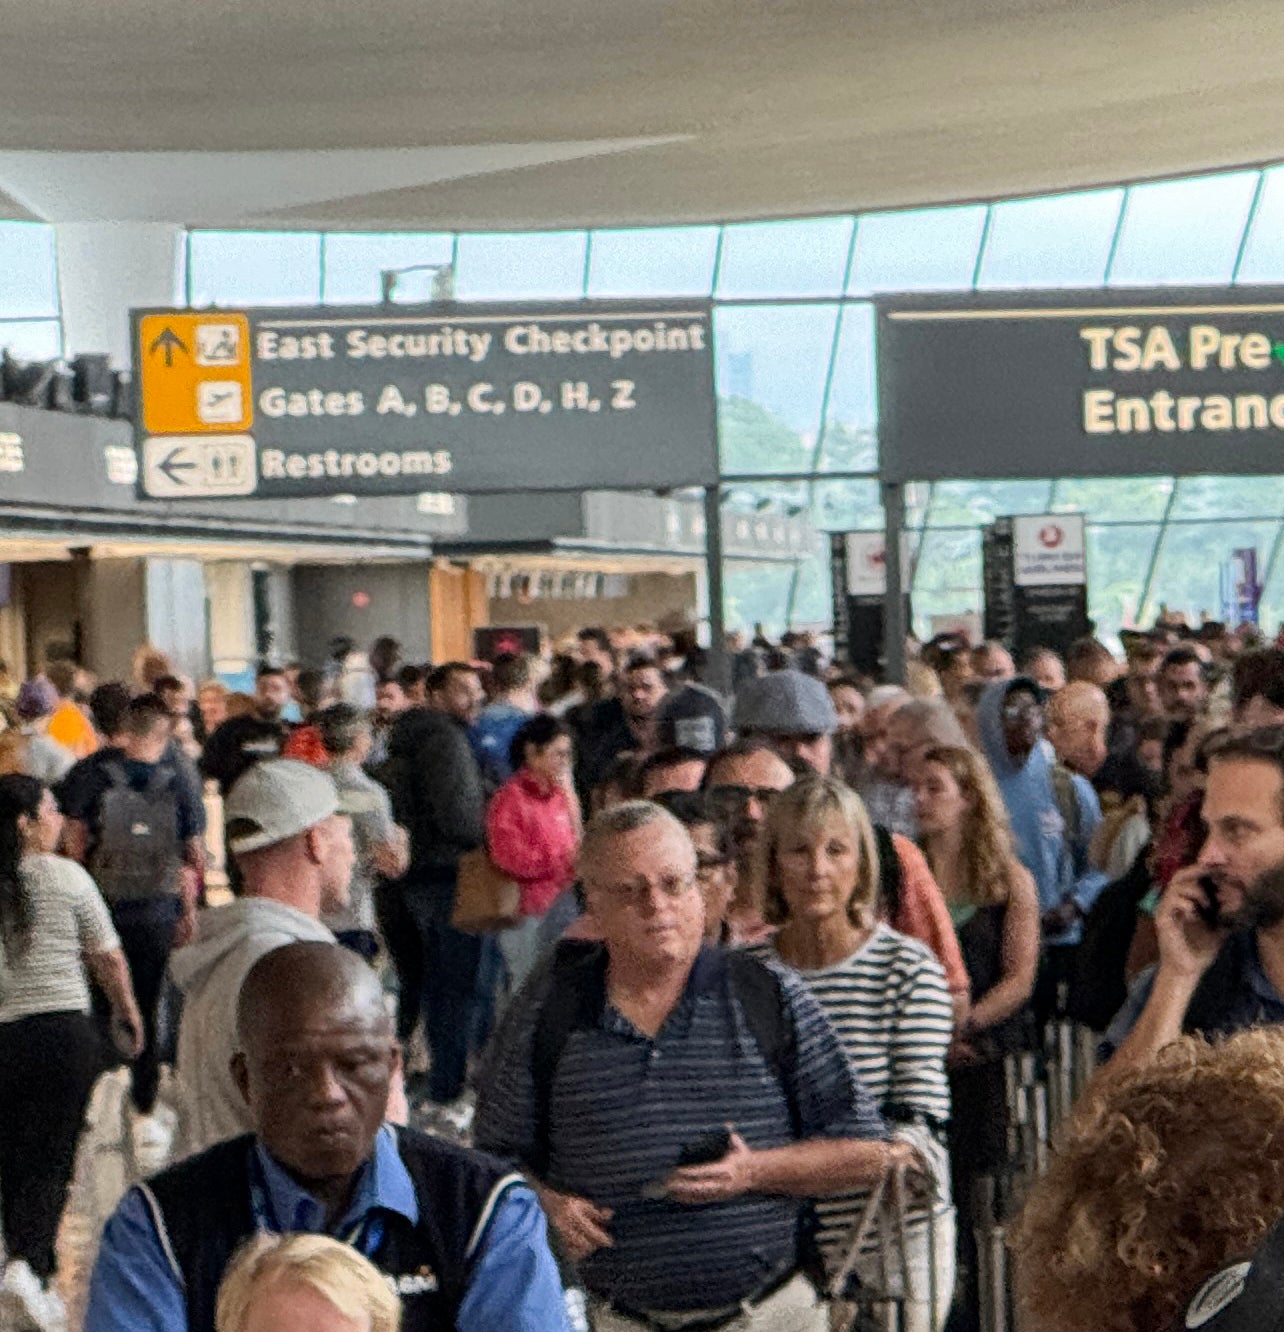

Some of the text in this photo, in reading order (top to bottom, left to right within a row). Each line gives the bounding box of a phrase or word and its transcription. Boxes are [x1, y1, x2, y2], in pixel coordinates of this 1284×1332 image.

[256, 322, 705, 361] East Security Checkpoint
[1080, 324, 1272, 371] TSA Pre
[259, 379, 637, 417] Gates A, B, C, D, H, Z
[261, 448, 451, 478] Restrooms
